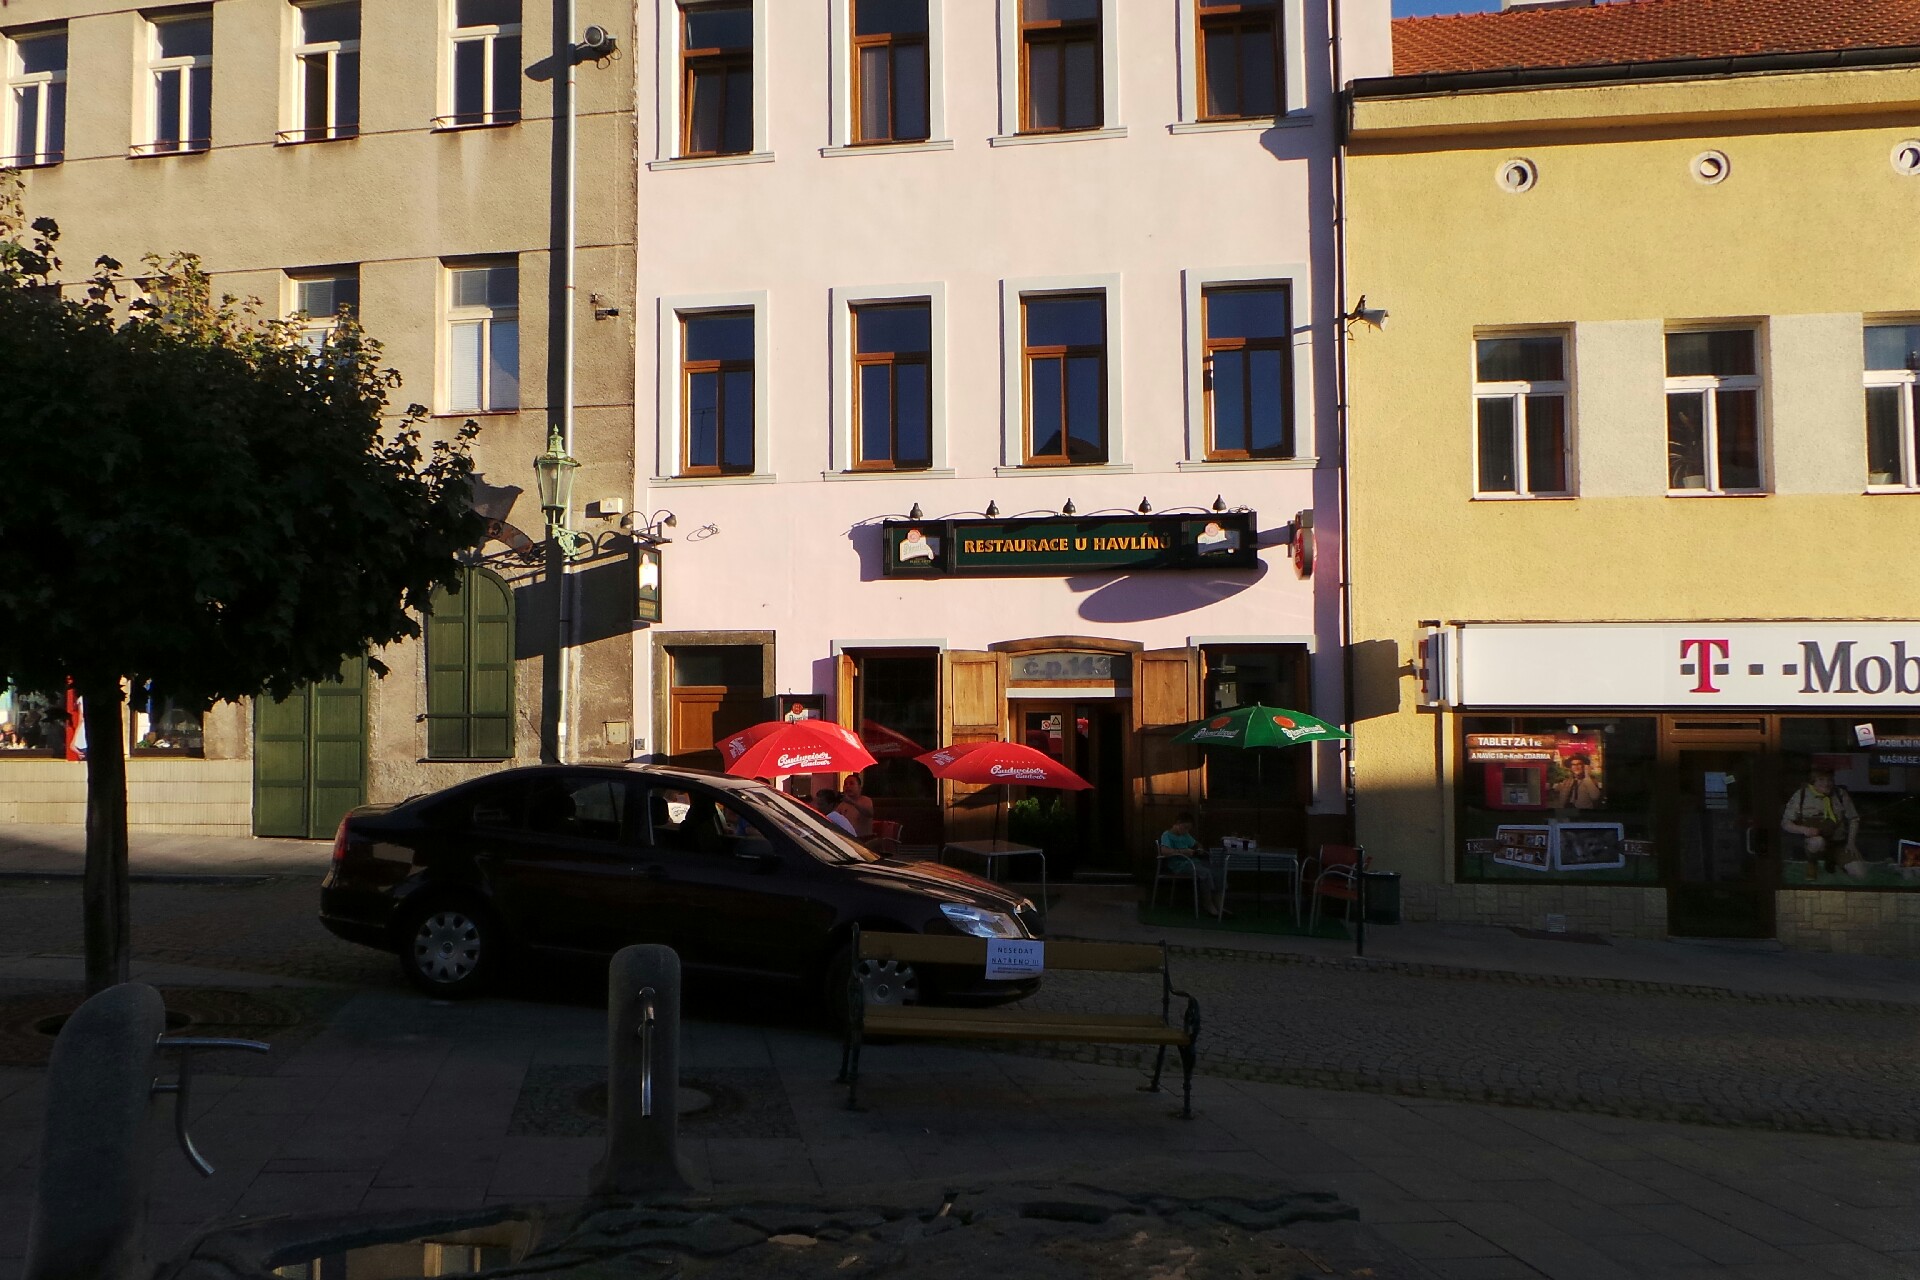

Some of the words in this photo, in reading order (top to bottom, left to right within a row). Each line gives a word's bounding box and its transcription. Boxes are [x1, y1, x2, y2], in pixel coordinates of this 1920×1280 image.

[964, 538, 1069, 553] RESTAURACE
[1074, 537, 1087, 551] U
[1478, 737, 1513, 746] TABLET
[1514, 738, 1527, 746] ZA
[1529, 738, 1533, 747] 1
